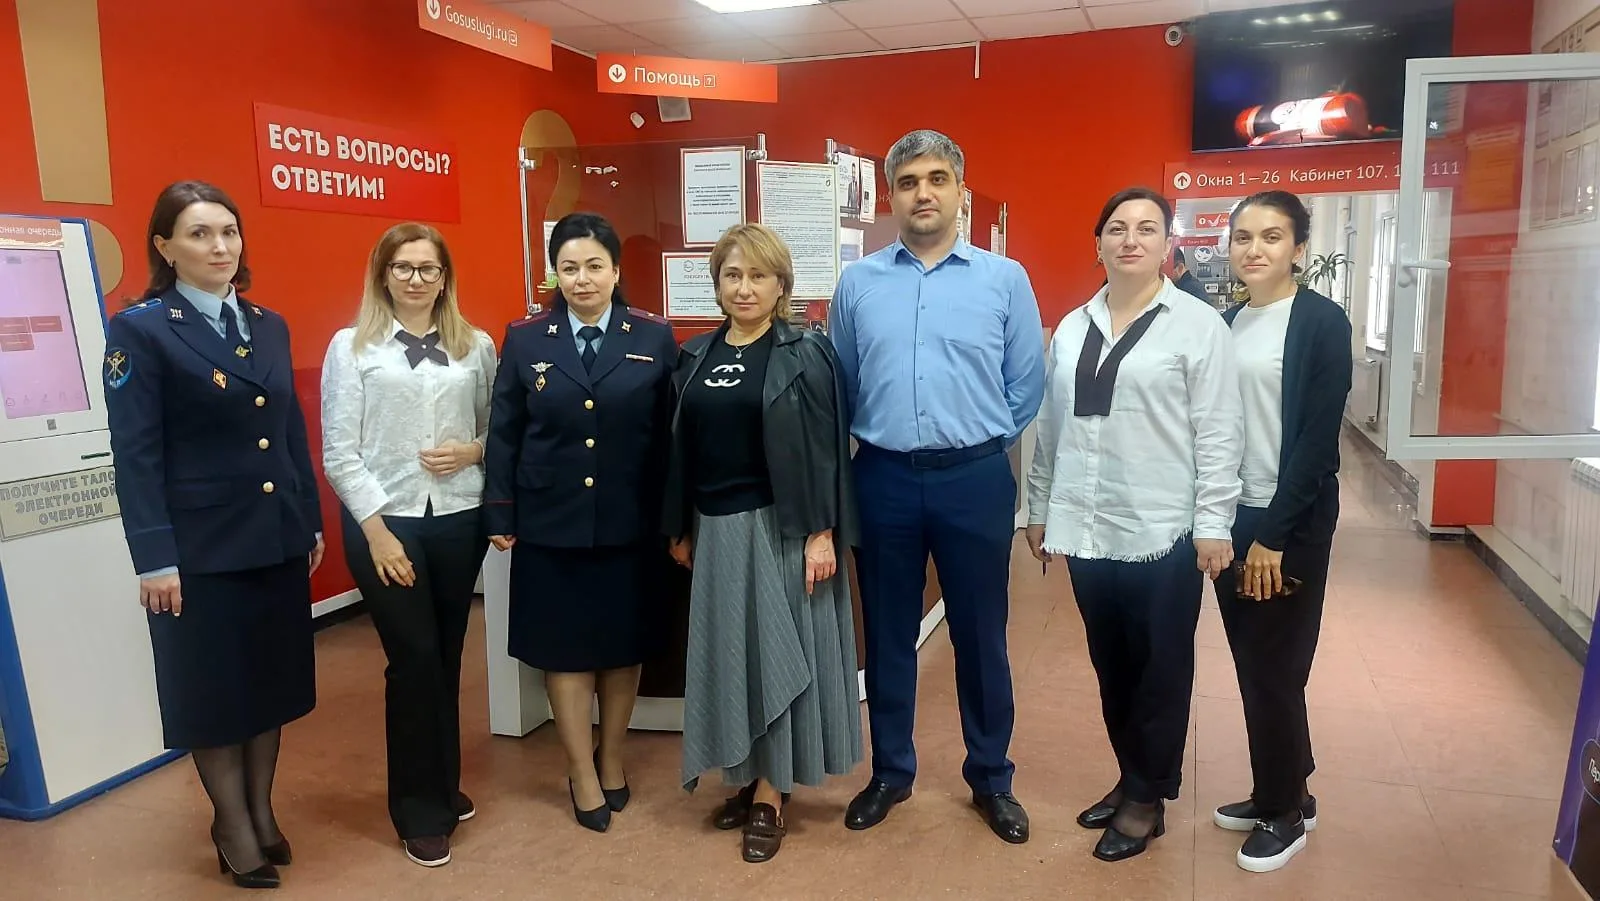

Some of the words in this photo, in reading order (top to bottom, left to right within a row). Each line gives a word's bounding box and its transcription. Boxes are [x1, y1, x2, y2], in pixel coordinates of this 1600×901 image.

[445, 5, 507, 41] Gosuslugi.ru
[634, 67, 701, 88] Помощь
[268, 123, 330, 157] ЕСТЬ
[336, 135, 451, 175] ВОПРОСЫ?
[271, 164, 385, 200] ОТВЕТИМ!
[1196, 174, 1233, 187] Окна
[1289, 168, 1353, 182] Кабинет
[1431, 161, 1460, 175] 111
[27, 227, 62, 237] очередь
[0, 476, 78, 501] ПОЛУЧИТЕ
[15, 483, 117, 514] ЭЛЕКТРОННОЙ
[38, 501, 104, 525] ОЧЕРЕДИ
